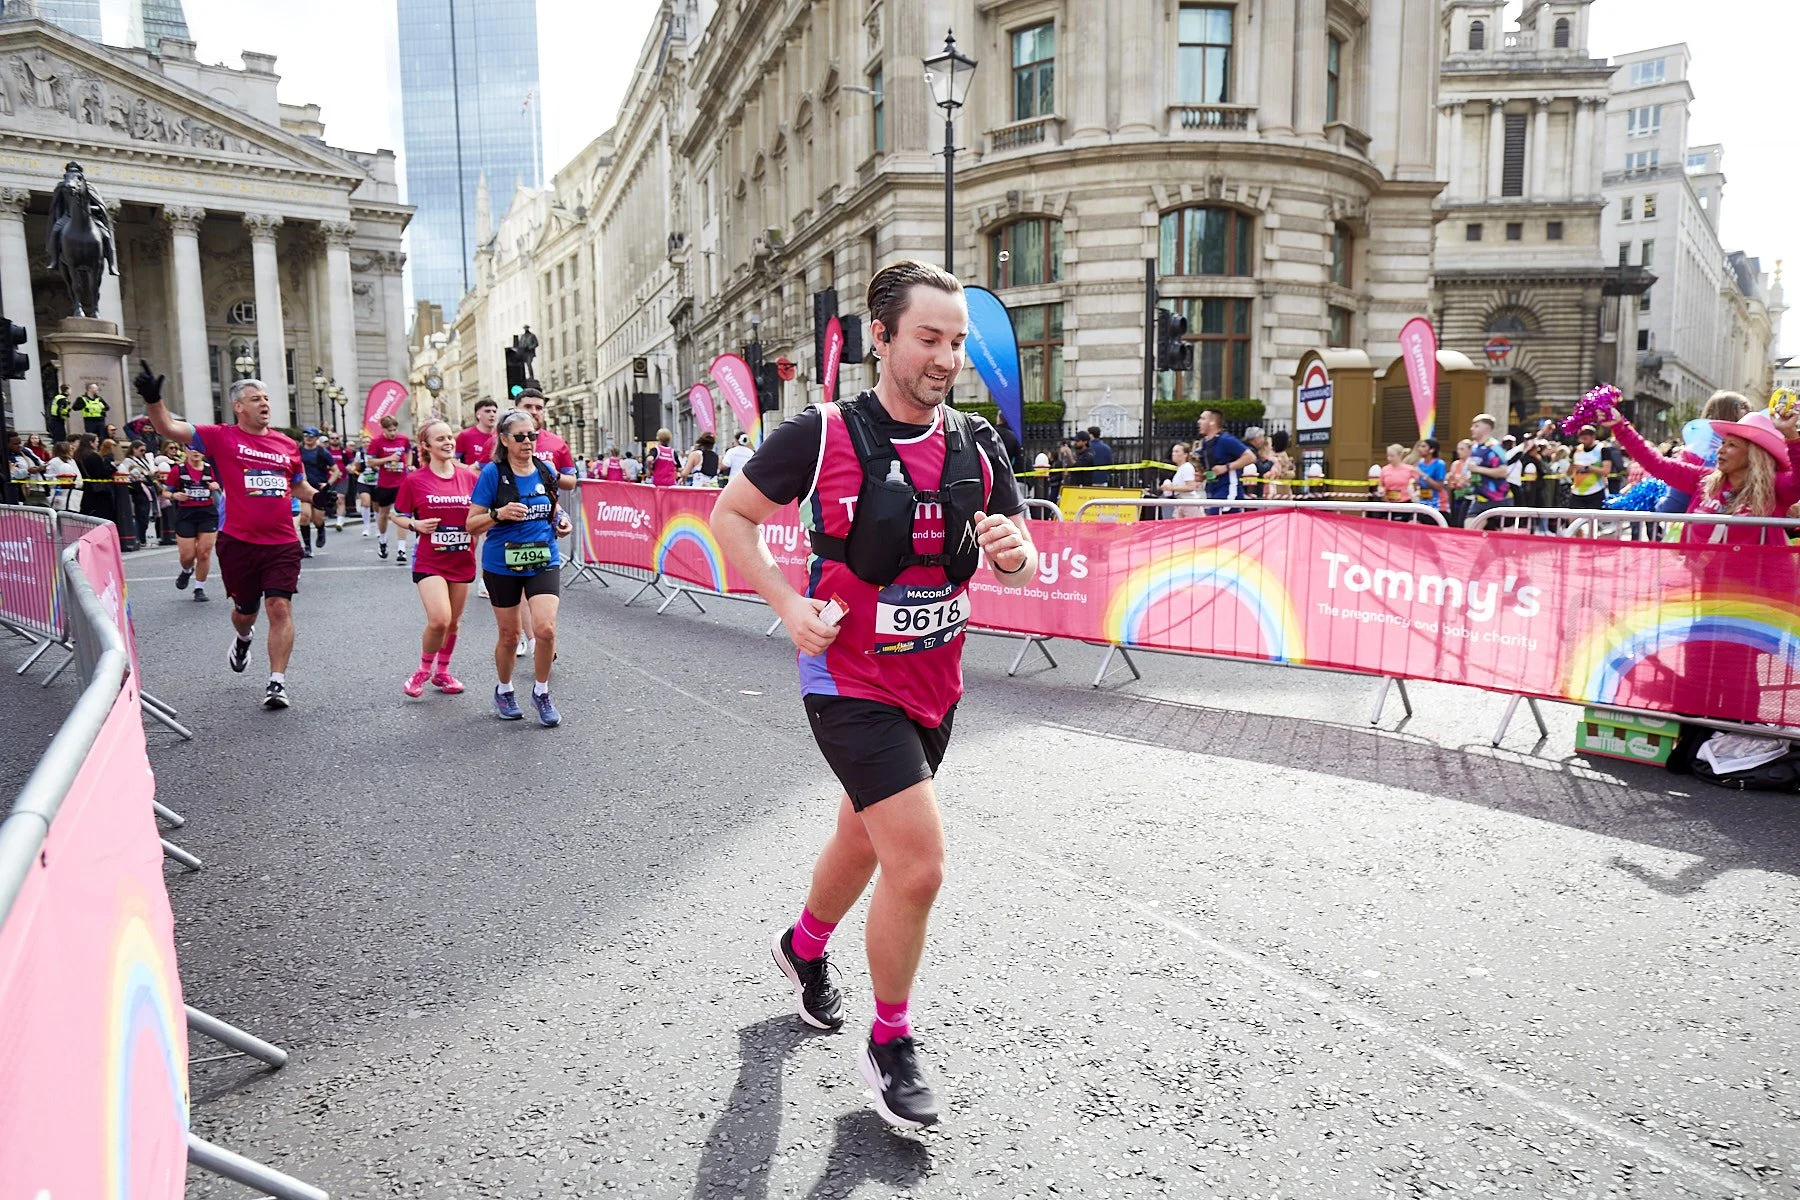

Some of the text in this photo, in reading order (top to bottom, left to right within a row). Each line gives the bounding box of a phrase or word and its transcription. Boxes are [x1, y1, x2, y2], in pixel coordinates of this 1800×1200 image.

[237, 443, 290, 464] Tommy's
[250, 477, 285, 488] 10693
[435, 533, 469, 543] 10217
[912, 529, 945, 539] and ba
[512, 550, 545, 562] 7494
[907, 584, 953, 599] MACORLEY
[1321, 551, 1542, 622] Tommy's
[1003, 586, 1022, 596] and
[1023, 586, 1049, 600] baby
[1051, 590, 1088, 604] charity
[893, 599, 961, 632] 9618
[1317, 603, 1537, 652] The pregnancy and baby charity
